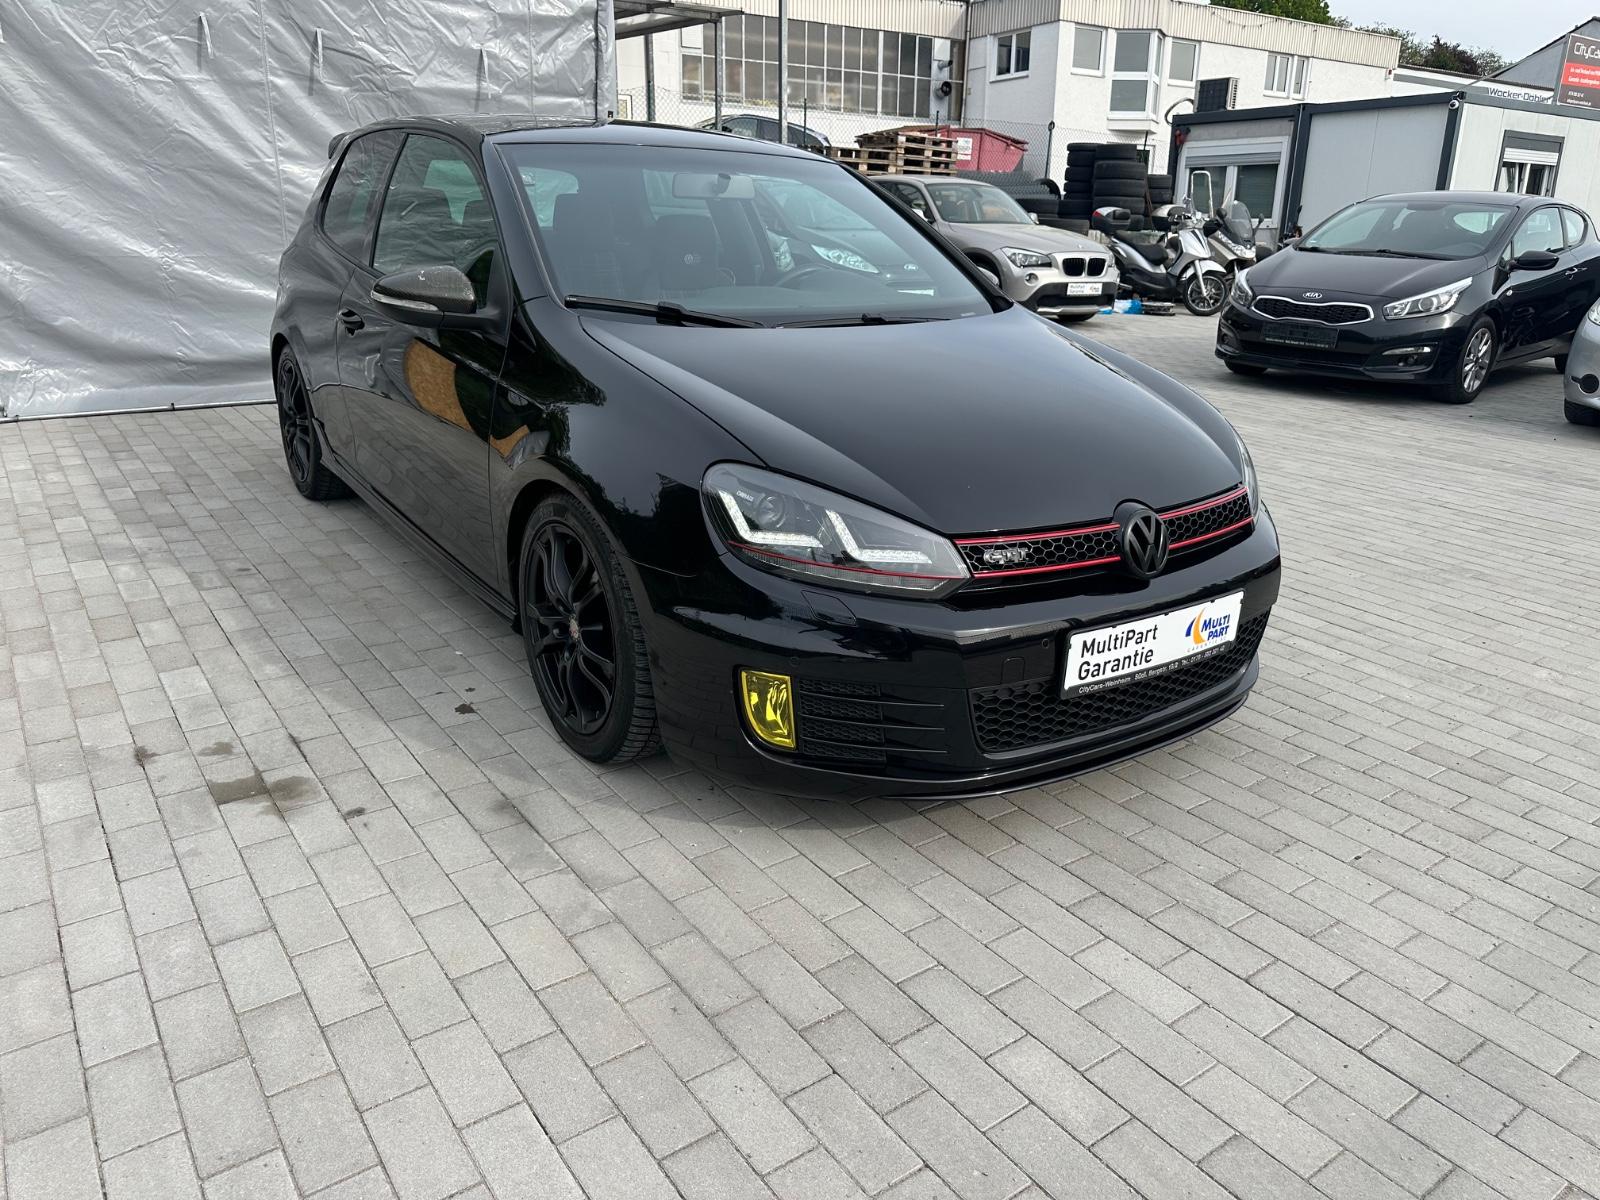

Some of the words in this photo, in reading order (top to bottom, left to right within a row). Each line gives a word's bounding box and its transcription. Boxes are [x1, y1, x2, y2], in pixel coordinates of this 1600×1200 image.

[1200, 613, 1231, 633] MULTI
[1207, 624, 1230, 641] PART
[1080, 624, 1158, 658] MultiPart
[1078, 647, 1154, 681] Garantie
